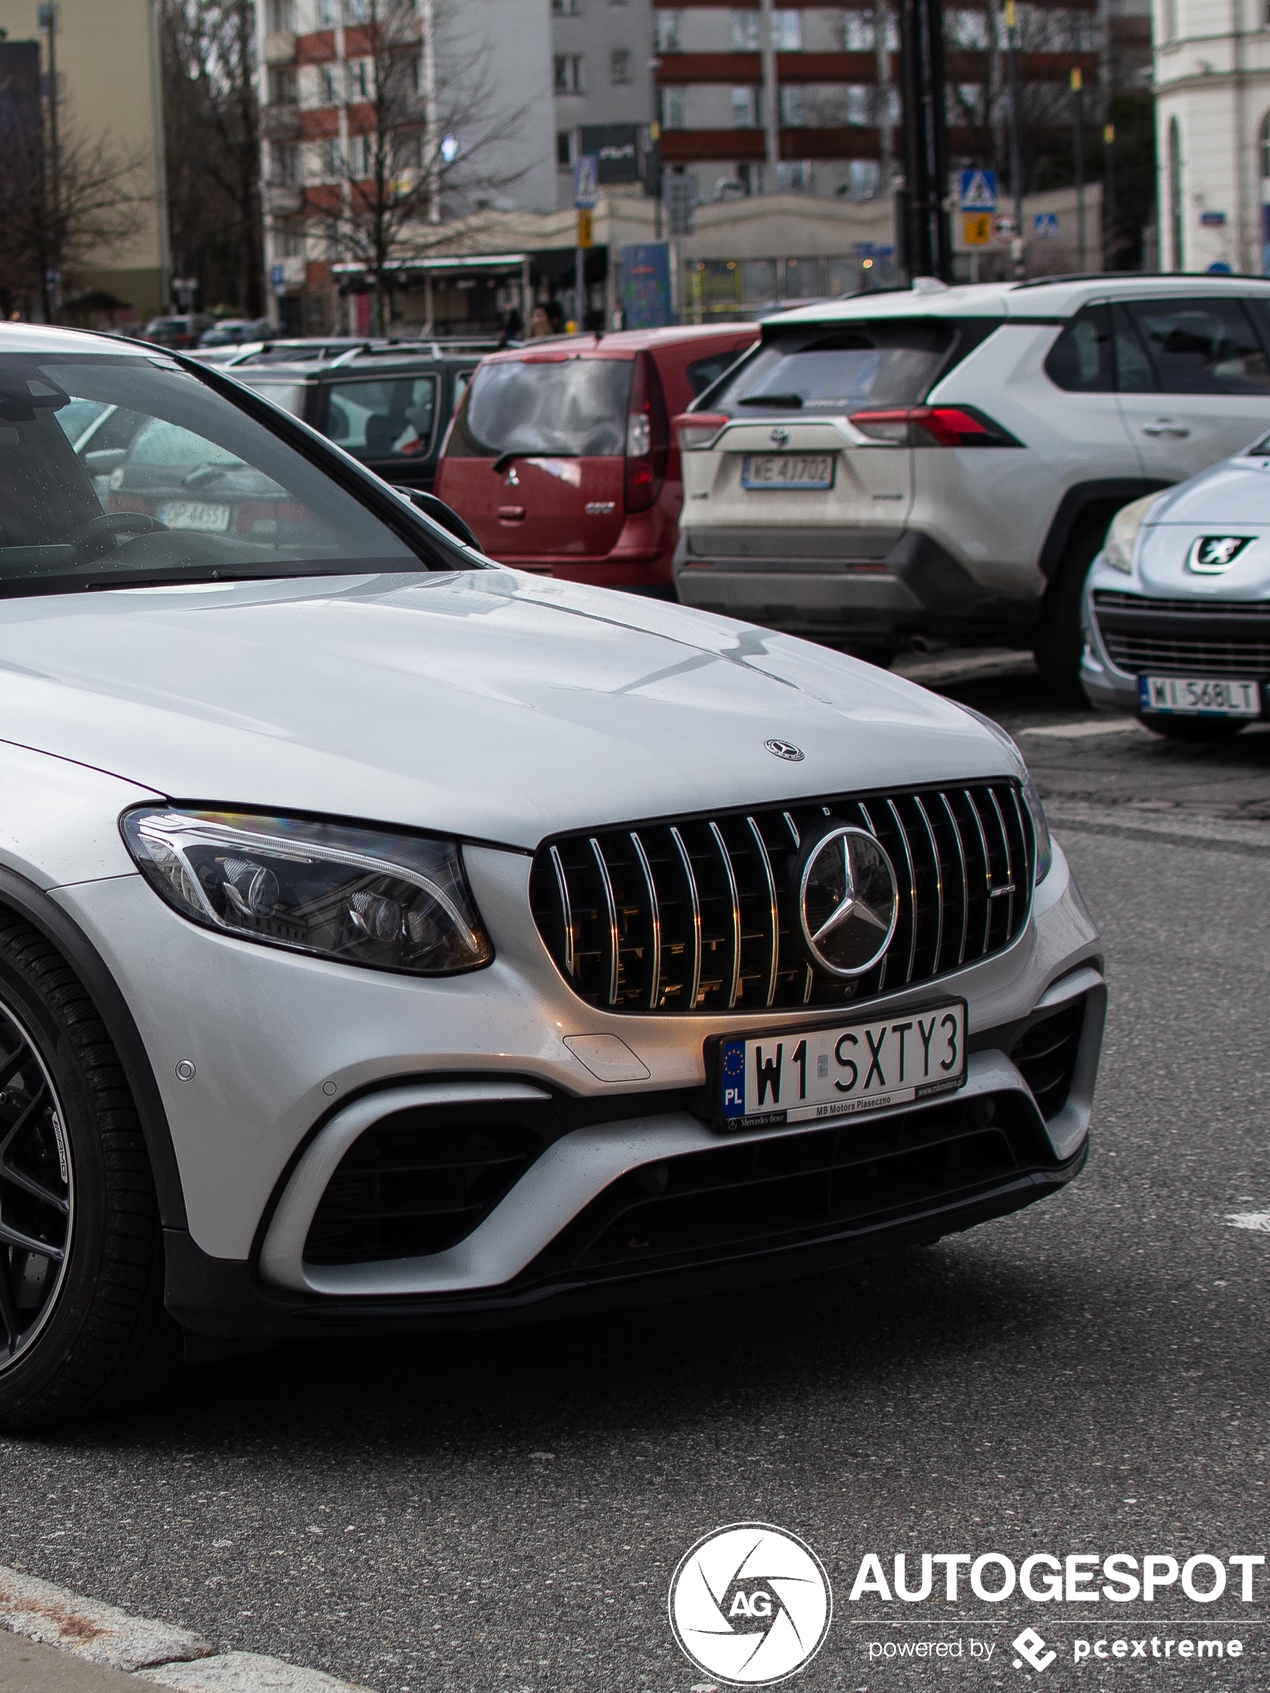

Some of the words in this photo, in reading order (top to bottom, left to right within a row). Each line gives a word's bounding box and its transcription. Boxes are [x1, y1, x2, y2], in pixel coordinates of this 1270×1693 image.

[755, 1039, 808, 1106] W1
[834, 1013, 958, 1092] SXTY3
[725, 1088, 742, 1106] PL
[816, 1106, 828, 1116] MB
[830, 1102, 855, 1114] Motors
[857, 1096, 891, 1110] Piaseczno
[918, 1077, 964, 1097] www.mbmotors.pl
